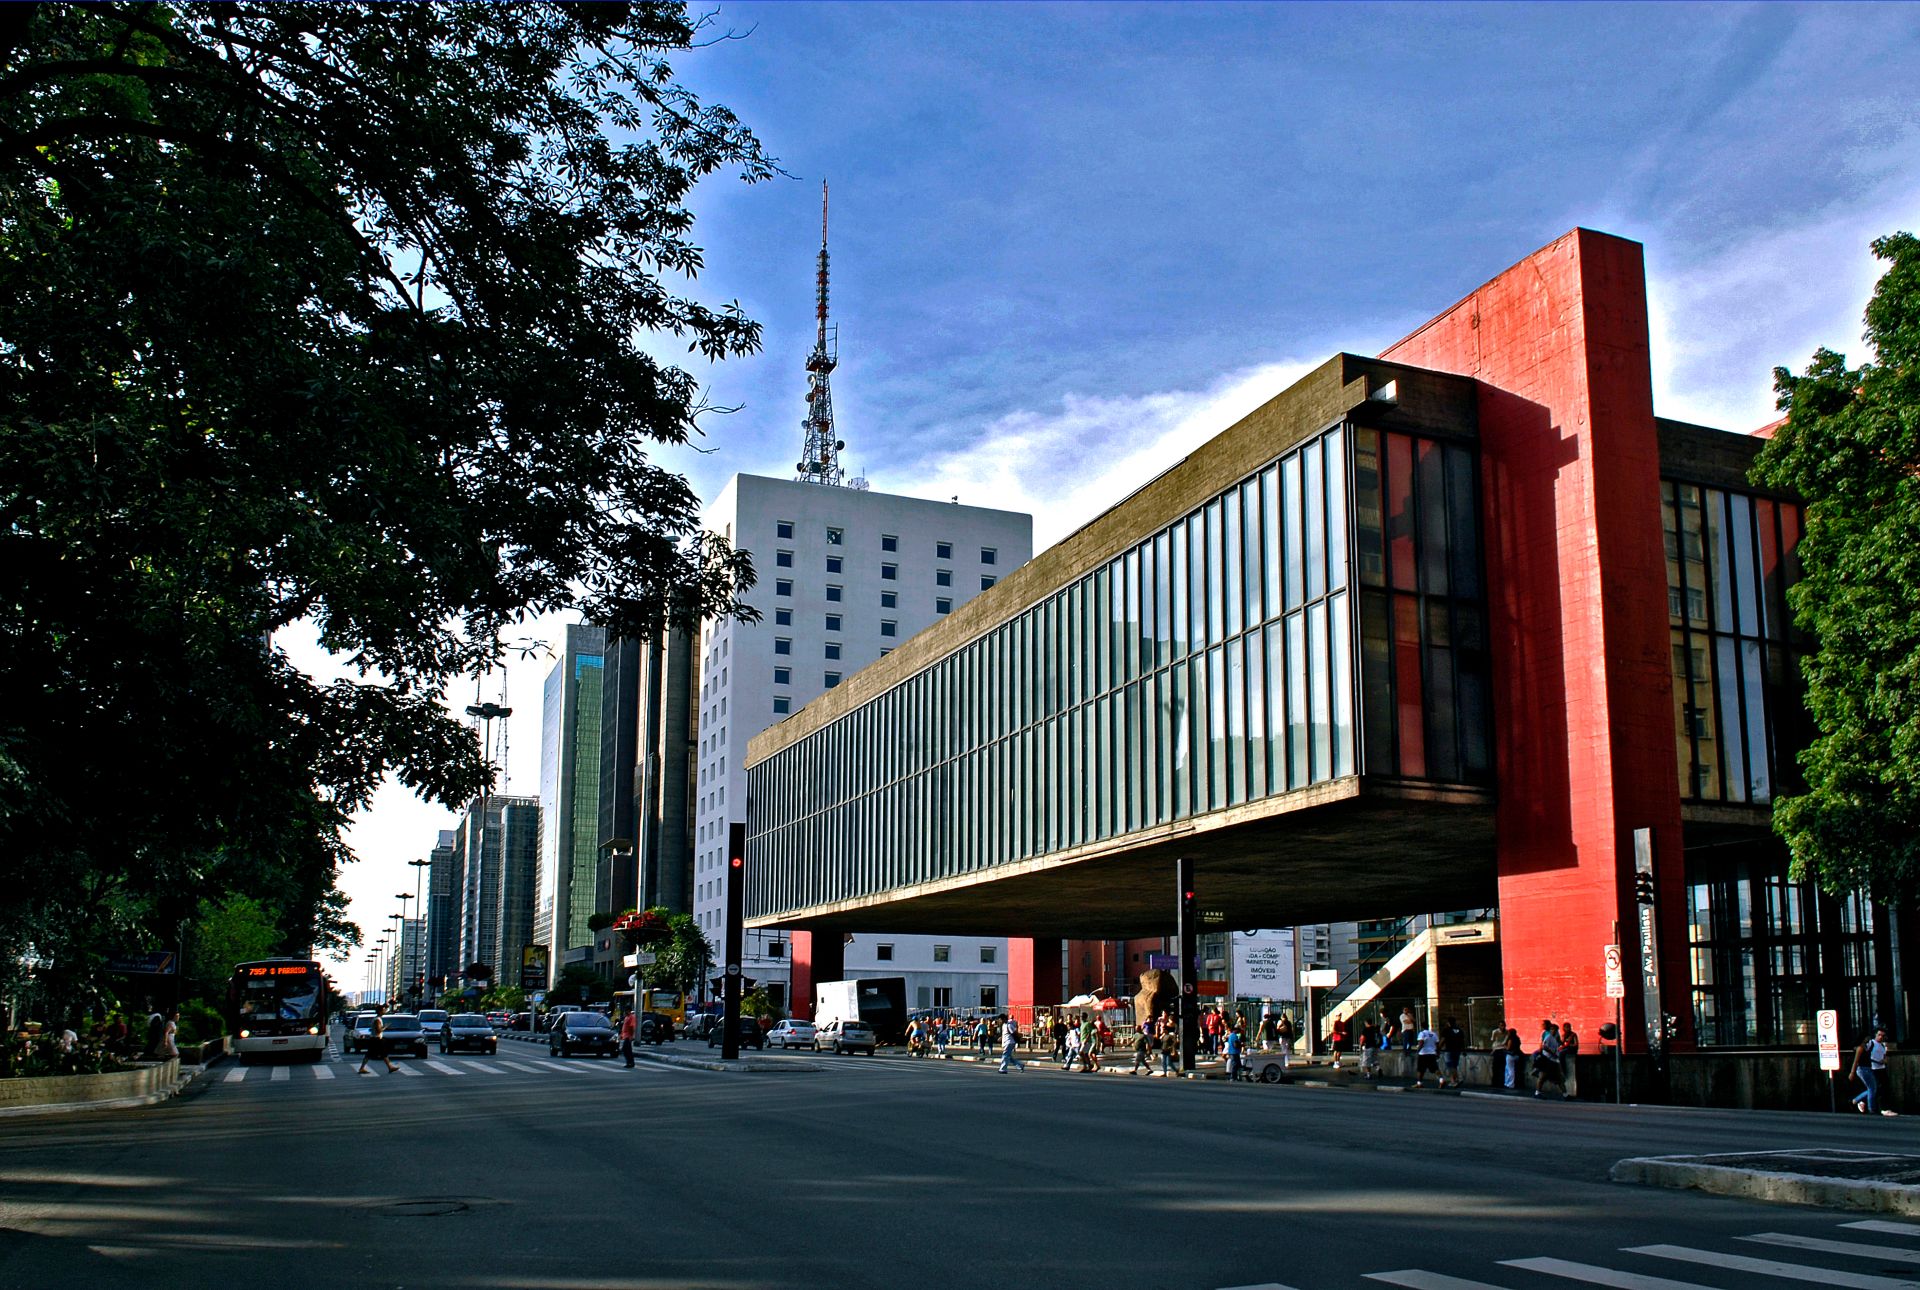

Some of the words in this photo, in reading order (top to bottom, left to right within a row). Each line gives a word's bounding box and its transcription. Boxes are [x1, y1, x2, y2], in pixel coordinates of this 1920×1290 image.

[1641, 908, 1652, 954] Paulista
[1644, 956, 1654, 972] Av.
[1824, 1016, 1829, 1026] E
